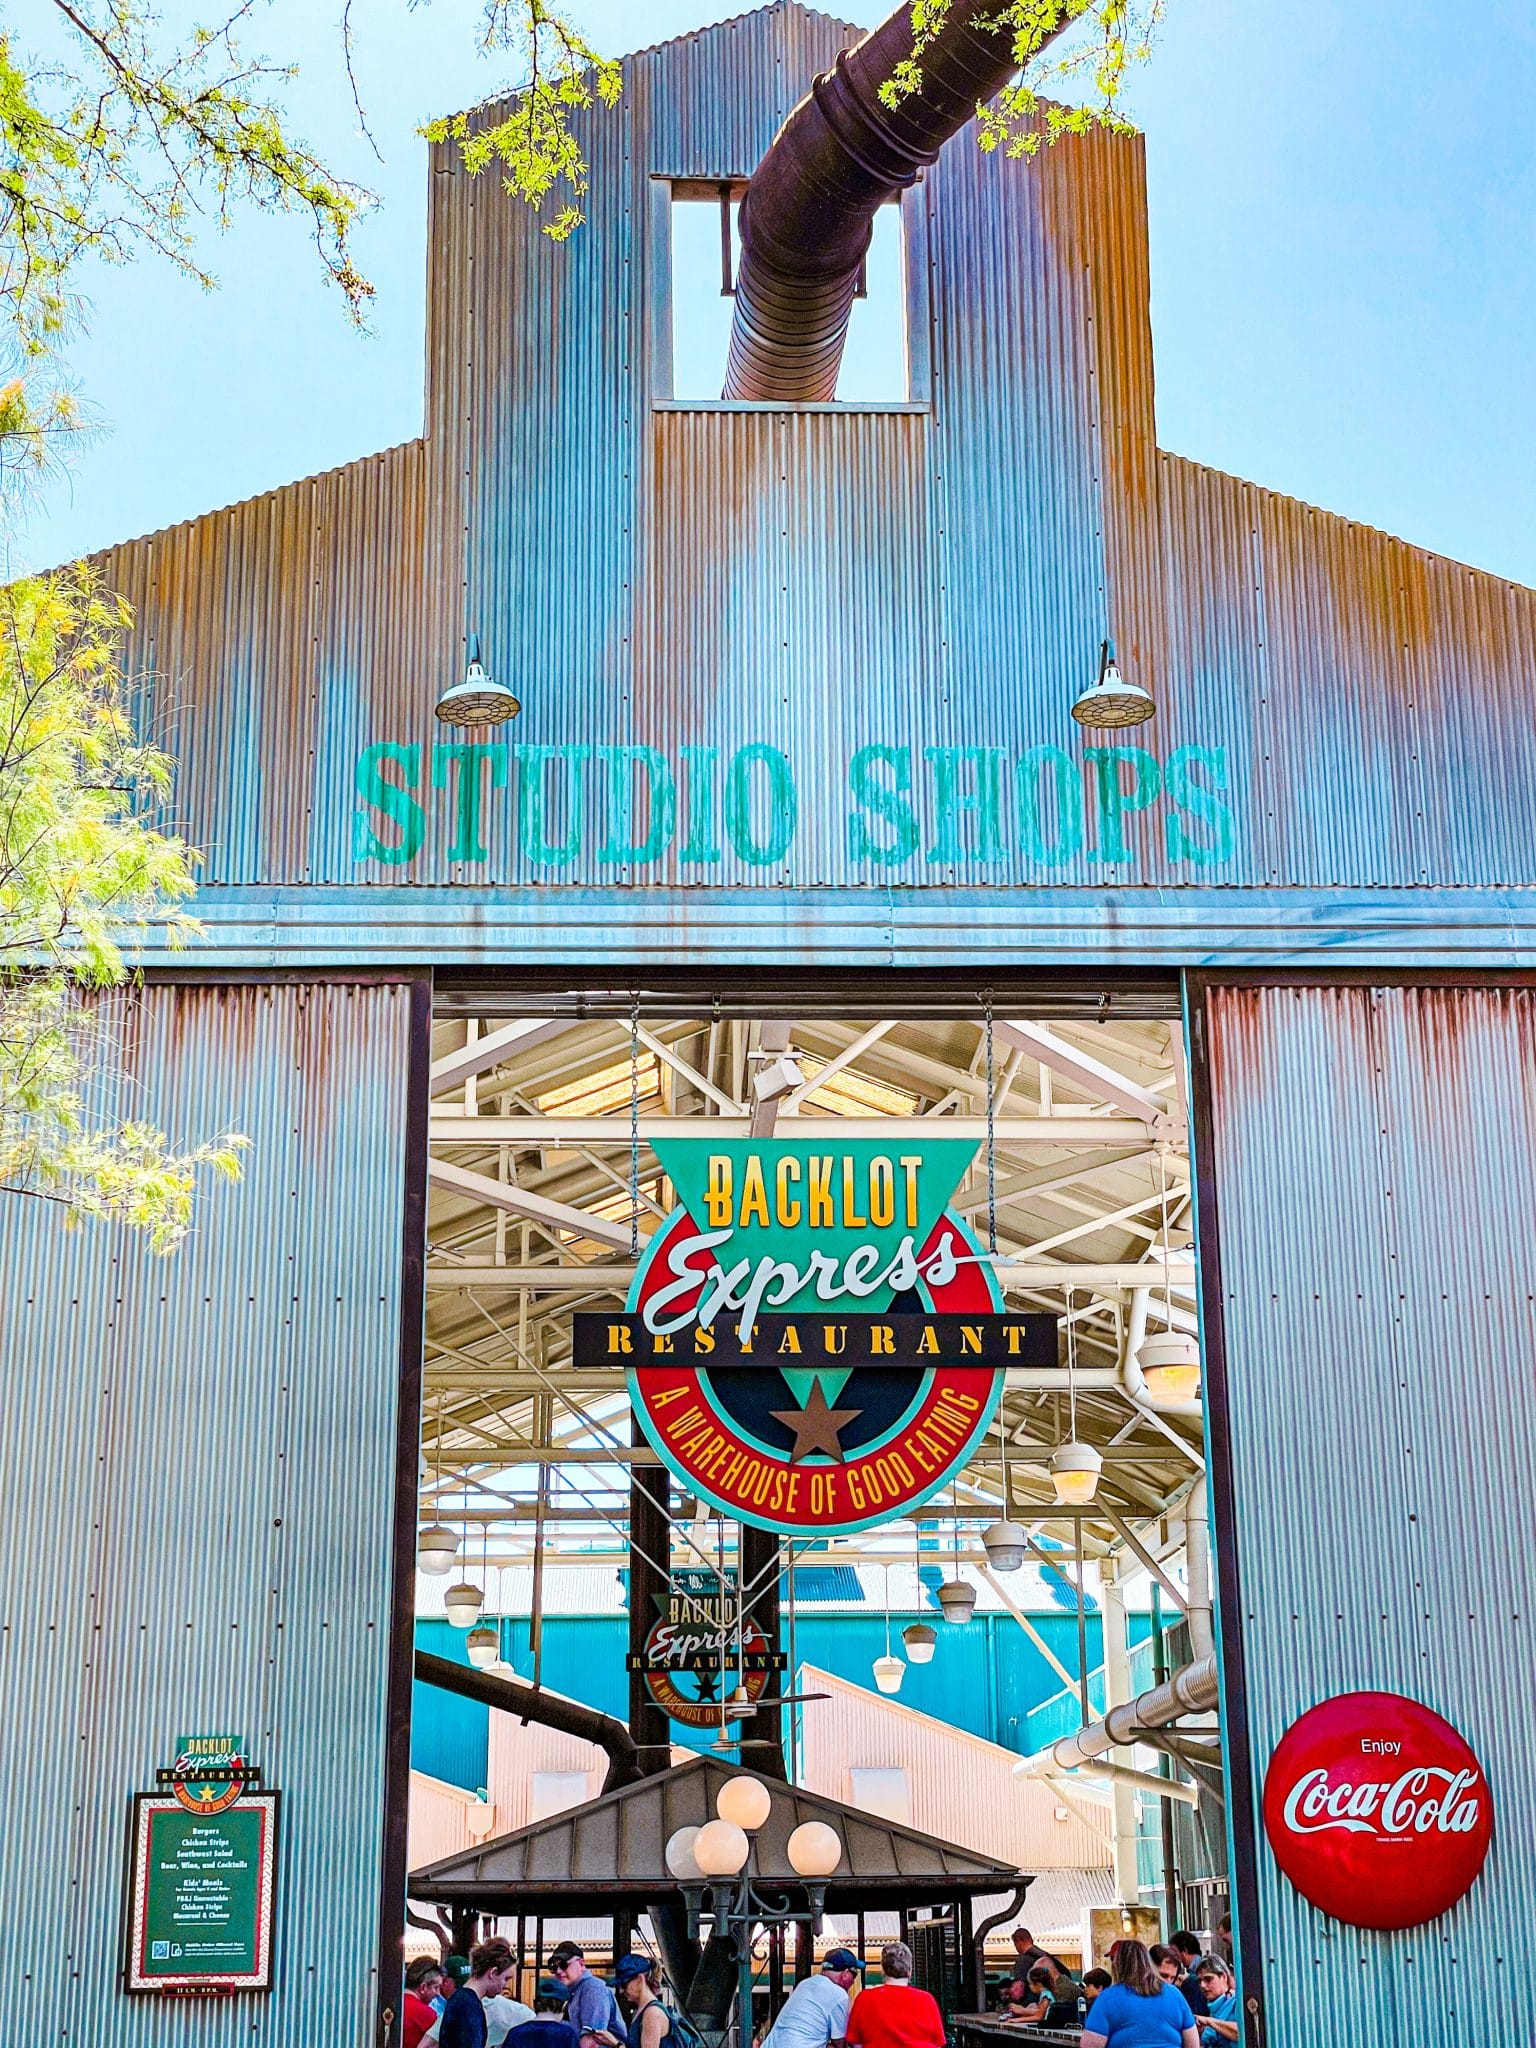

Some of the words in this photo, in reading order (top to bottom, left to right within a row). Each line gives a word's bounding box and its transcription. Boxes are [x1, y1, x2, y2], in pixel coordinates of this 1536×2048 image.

[352, 742, 797, 867] STUDIO
[848, 742, 1236, 867] SHOPS
[704, 1155, 922, 1228] BACKLOT
[643, 1229, 1018, 1345] Express
[607, 1325, 1026, 1354] RESTAURANT
[651, 1385, 690, 1410] A
[904, 1387, 980, 1473] EATING
[664, 1405, 801, 1514] WAREHOUSE
[811, 1472, 837, 1515] OF
[847, 1450, 916, 1510] GOOD
[648, 1625, 773, 1665] Express
[653, 1679, 665, 1688] A
[705, 1708, 718, 1721] OF
[175, 1751, 248, 1774] Express
[188, 1738, 233, 1754] BACKLOT
[1361, 1738, 1401, 1756] Enjoy
[162, 1771, 254, 1780] RESTAURANT
[1283, 1766, 1479, 1834] Coca-Cola
[181, 1838, 208, 1846] Chicken
[209, 1838, 230, 1847] Strips
[192, 1827, 220, 1836] Burgers
[160, 1862, 179, 1870] Beer,
[181, 1861, 200, 1869] Wine,
[202, 1861, 216, 1869] and
[217, 1860, 248, 1868] Cocktails
[176, 1850, 212, 1858] Southwest
[213, 1849, 234, 1857] Salad
